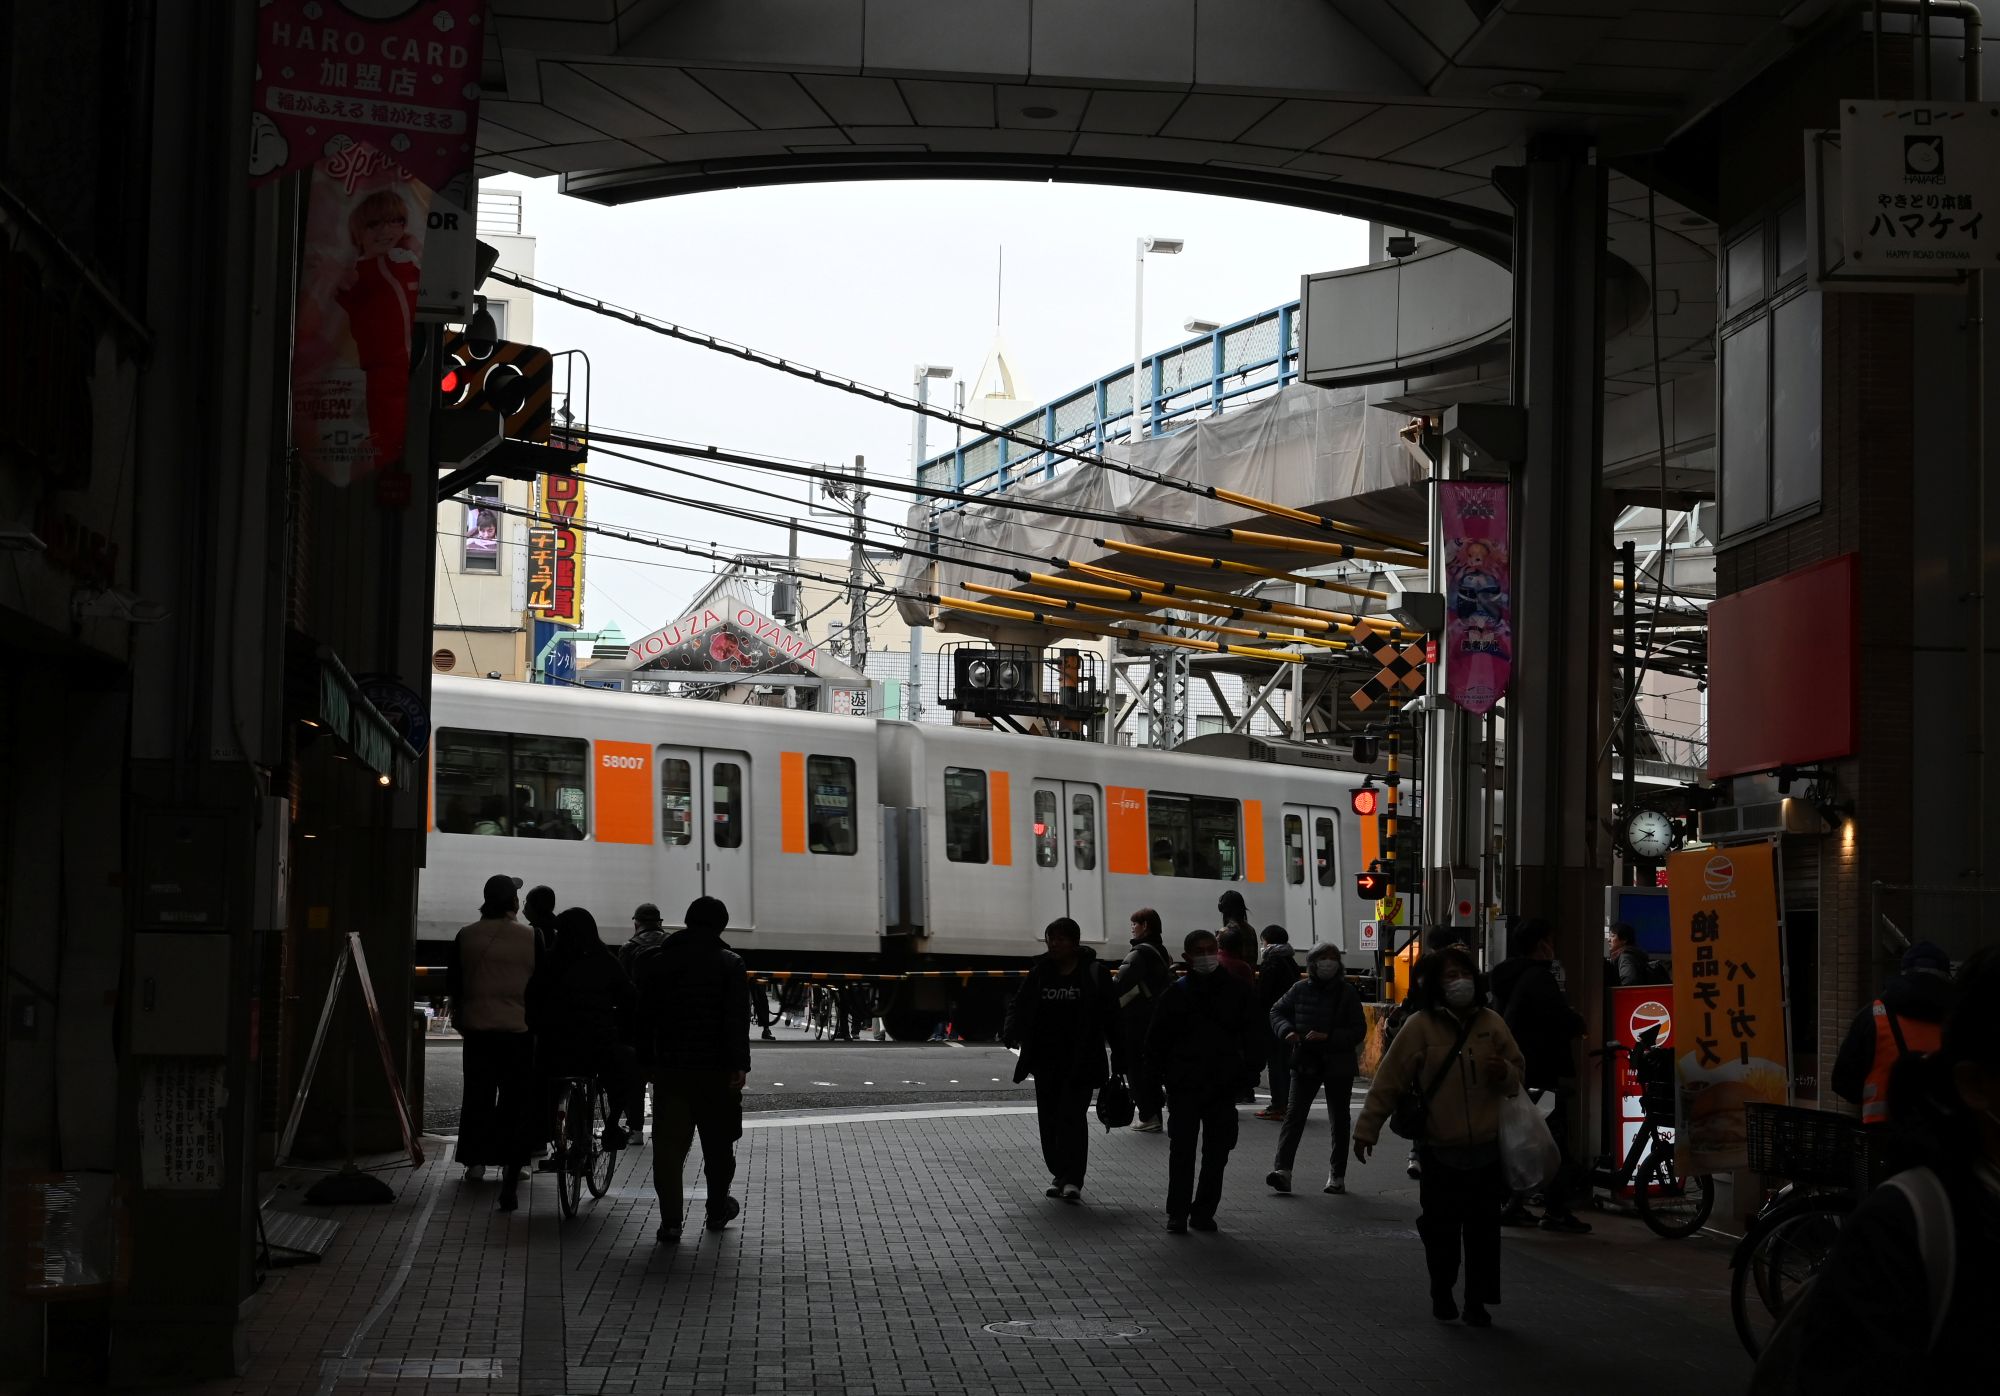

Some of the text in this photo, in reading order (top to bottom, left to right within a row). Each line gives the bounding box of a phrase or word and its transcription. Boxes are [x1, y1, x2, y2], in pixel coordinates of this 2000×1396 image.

[271, 21, 470, 70] HARO CARD
[319, 57, 418, 97] 加盟店
[277, 91, 454, 130] 福がふえる 福がたまる
[1904, 176, 1946, 185] HAMAKEI
[1878, 193, 1972, 210] やきとり本舗
[1869, 212, 1983, 240] ハマケイ
[529, 534, 554, 606] ナチュラル
[630, 608, 819, 668] YOU-ZA OYAMA
[602, 755, 645, 771] 58007
